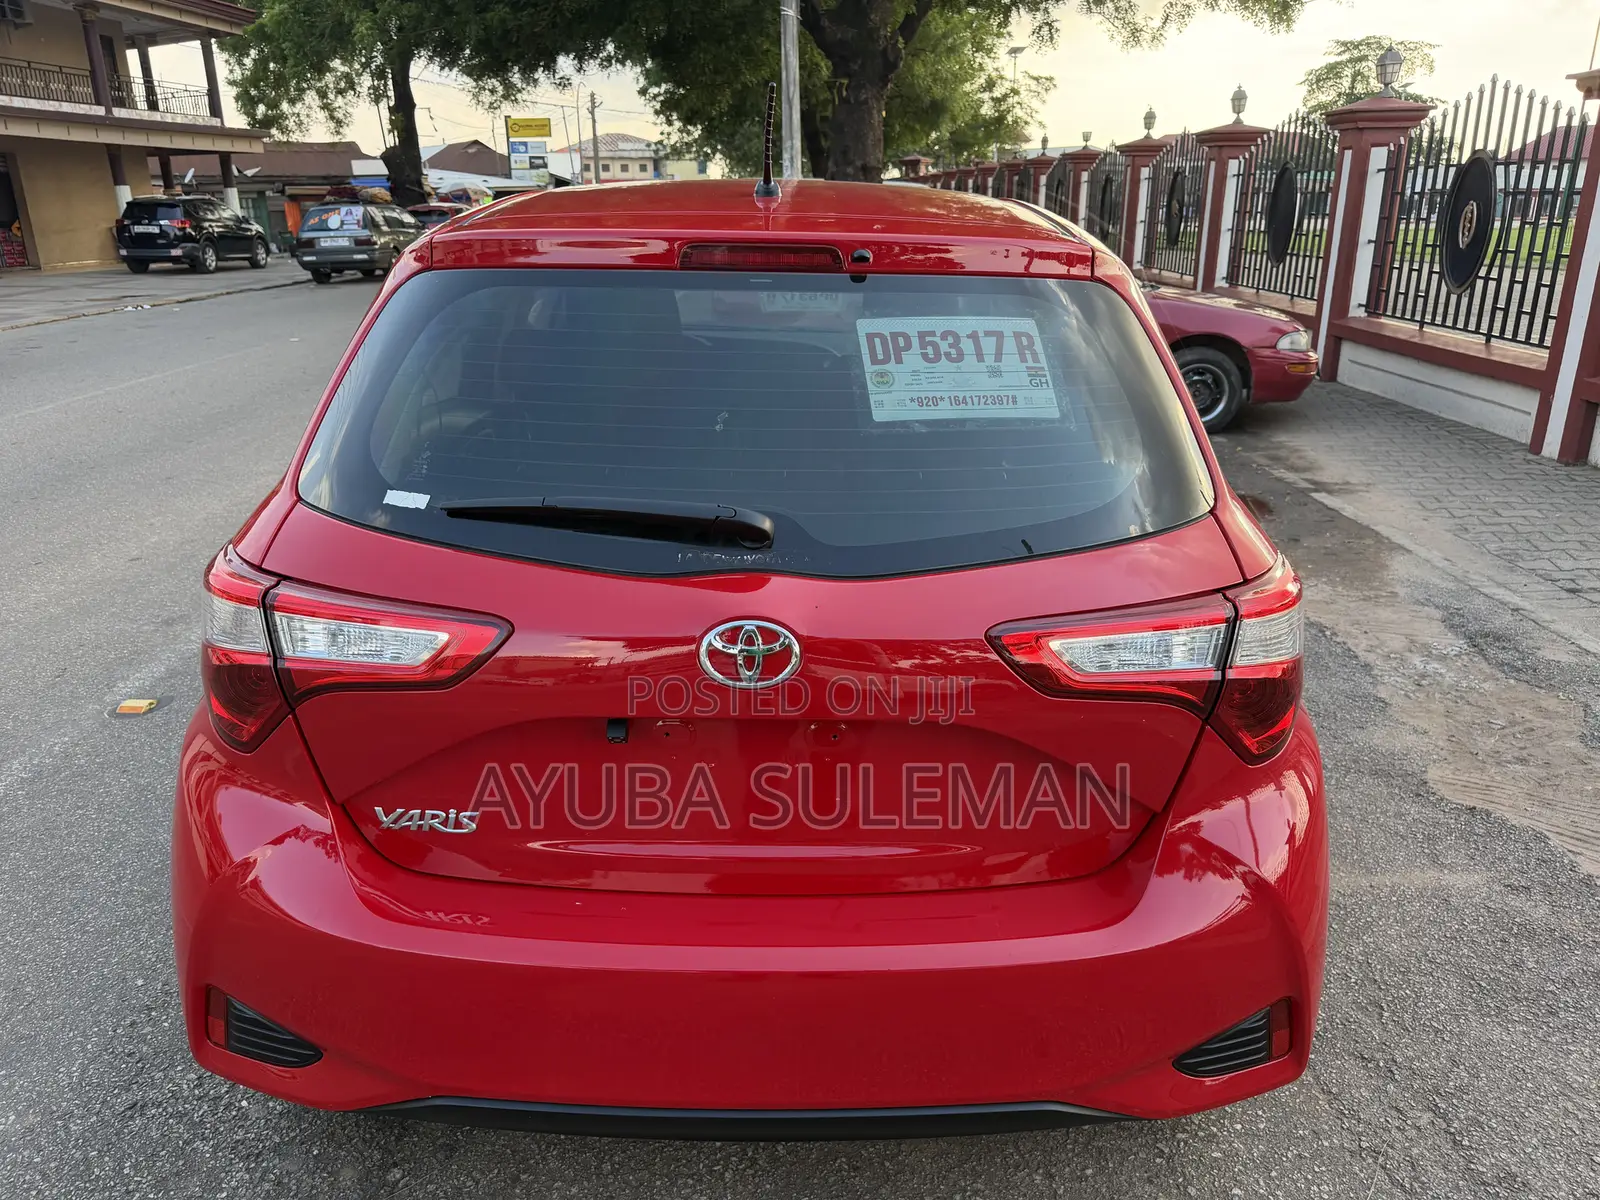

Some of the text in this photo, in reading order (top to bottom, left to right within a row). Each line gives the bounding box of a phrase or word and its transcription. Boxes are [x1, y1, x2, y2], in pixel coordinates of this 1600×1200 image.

[865, 330, 1042, 366] DP 5317 R
[1029, 378, 1050, 388] GH
